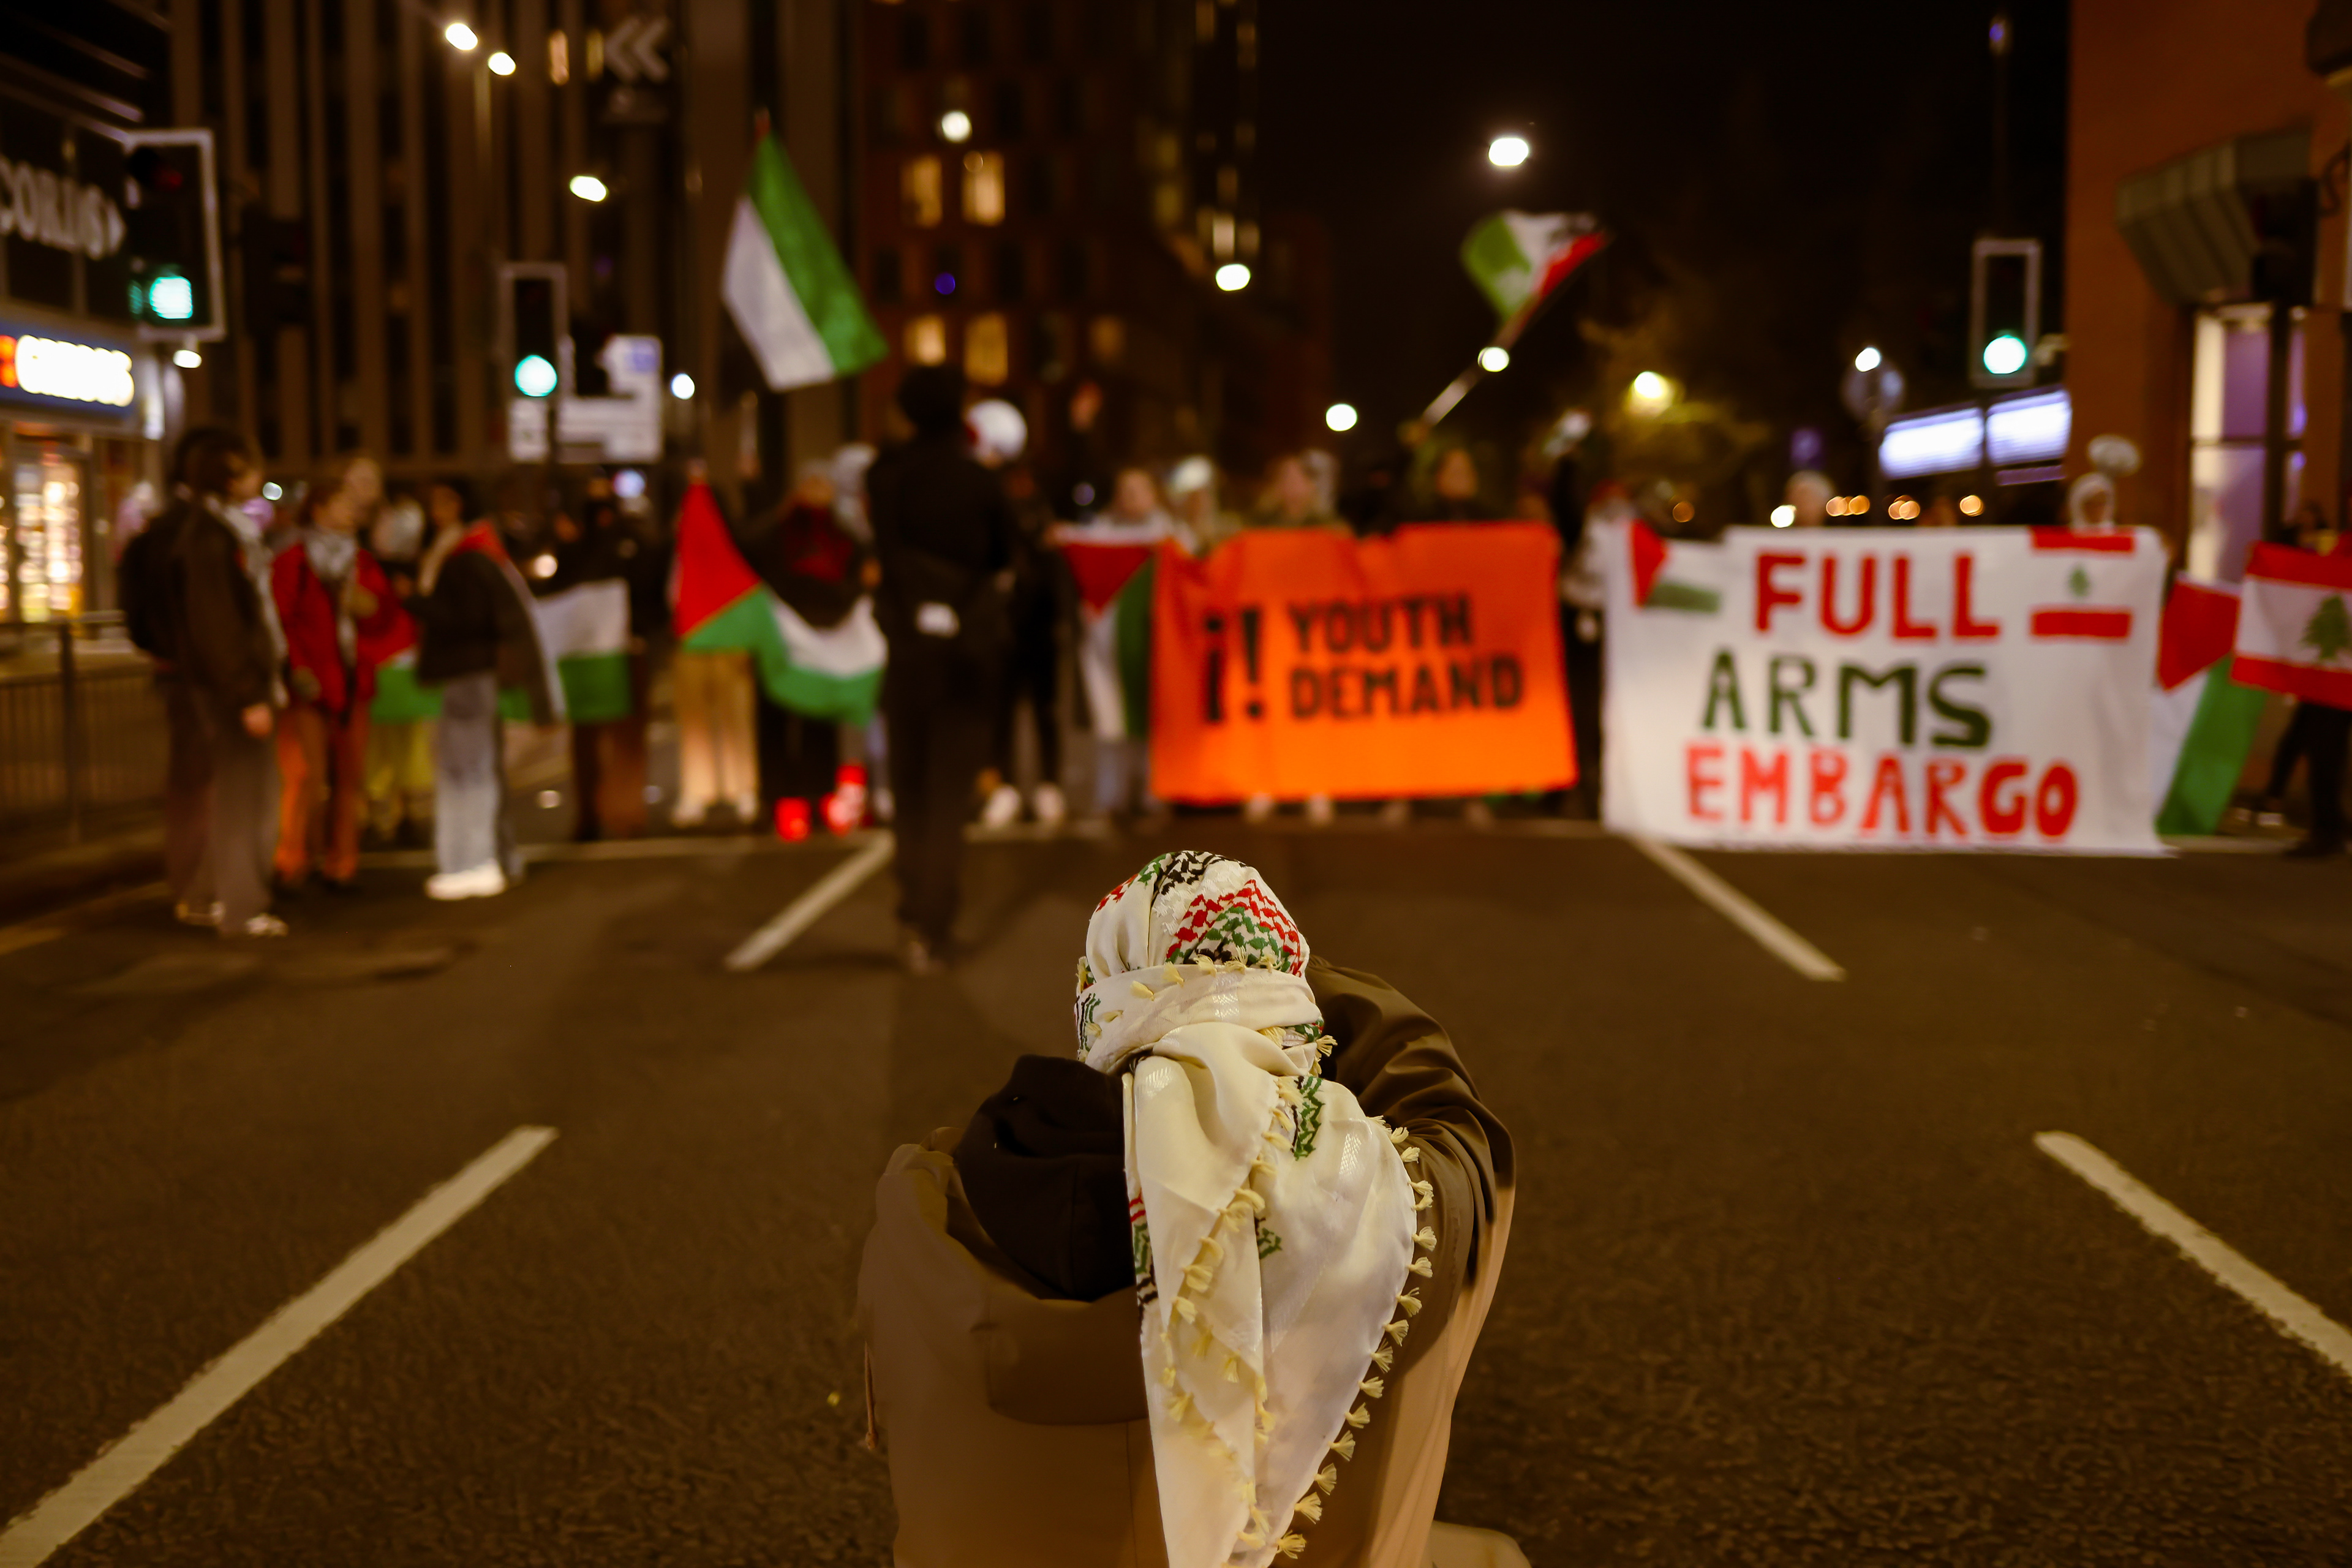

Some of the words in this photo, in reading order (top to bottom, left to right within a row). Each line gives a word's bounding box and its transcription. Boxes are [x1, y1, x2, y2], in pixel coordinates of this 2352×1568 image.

[1290, 594, 1472, 652] YOUTH
[1754, 550, 2000, 638] FULL
[1290, 655, 1524, 719] DEMAND
[1703, 650, 1992, 748] ARMS
[1686, 740, 2079, 840] EMBARGO
